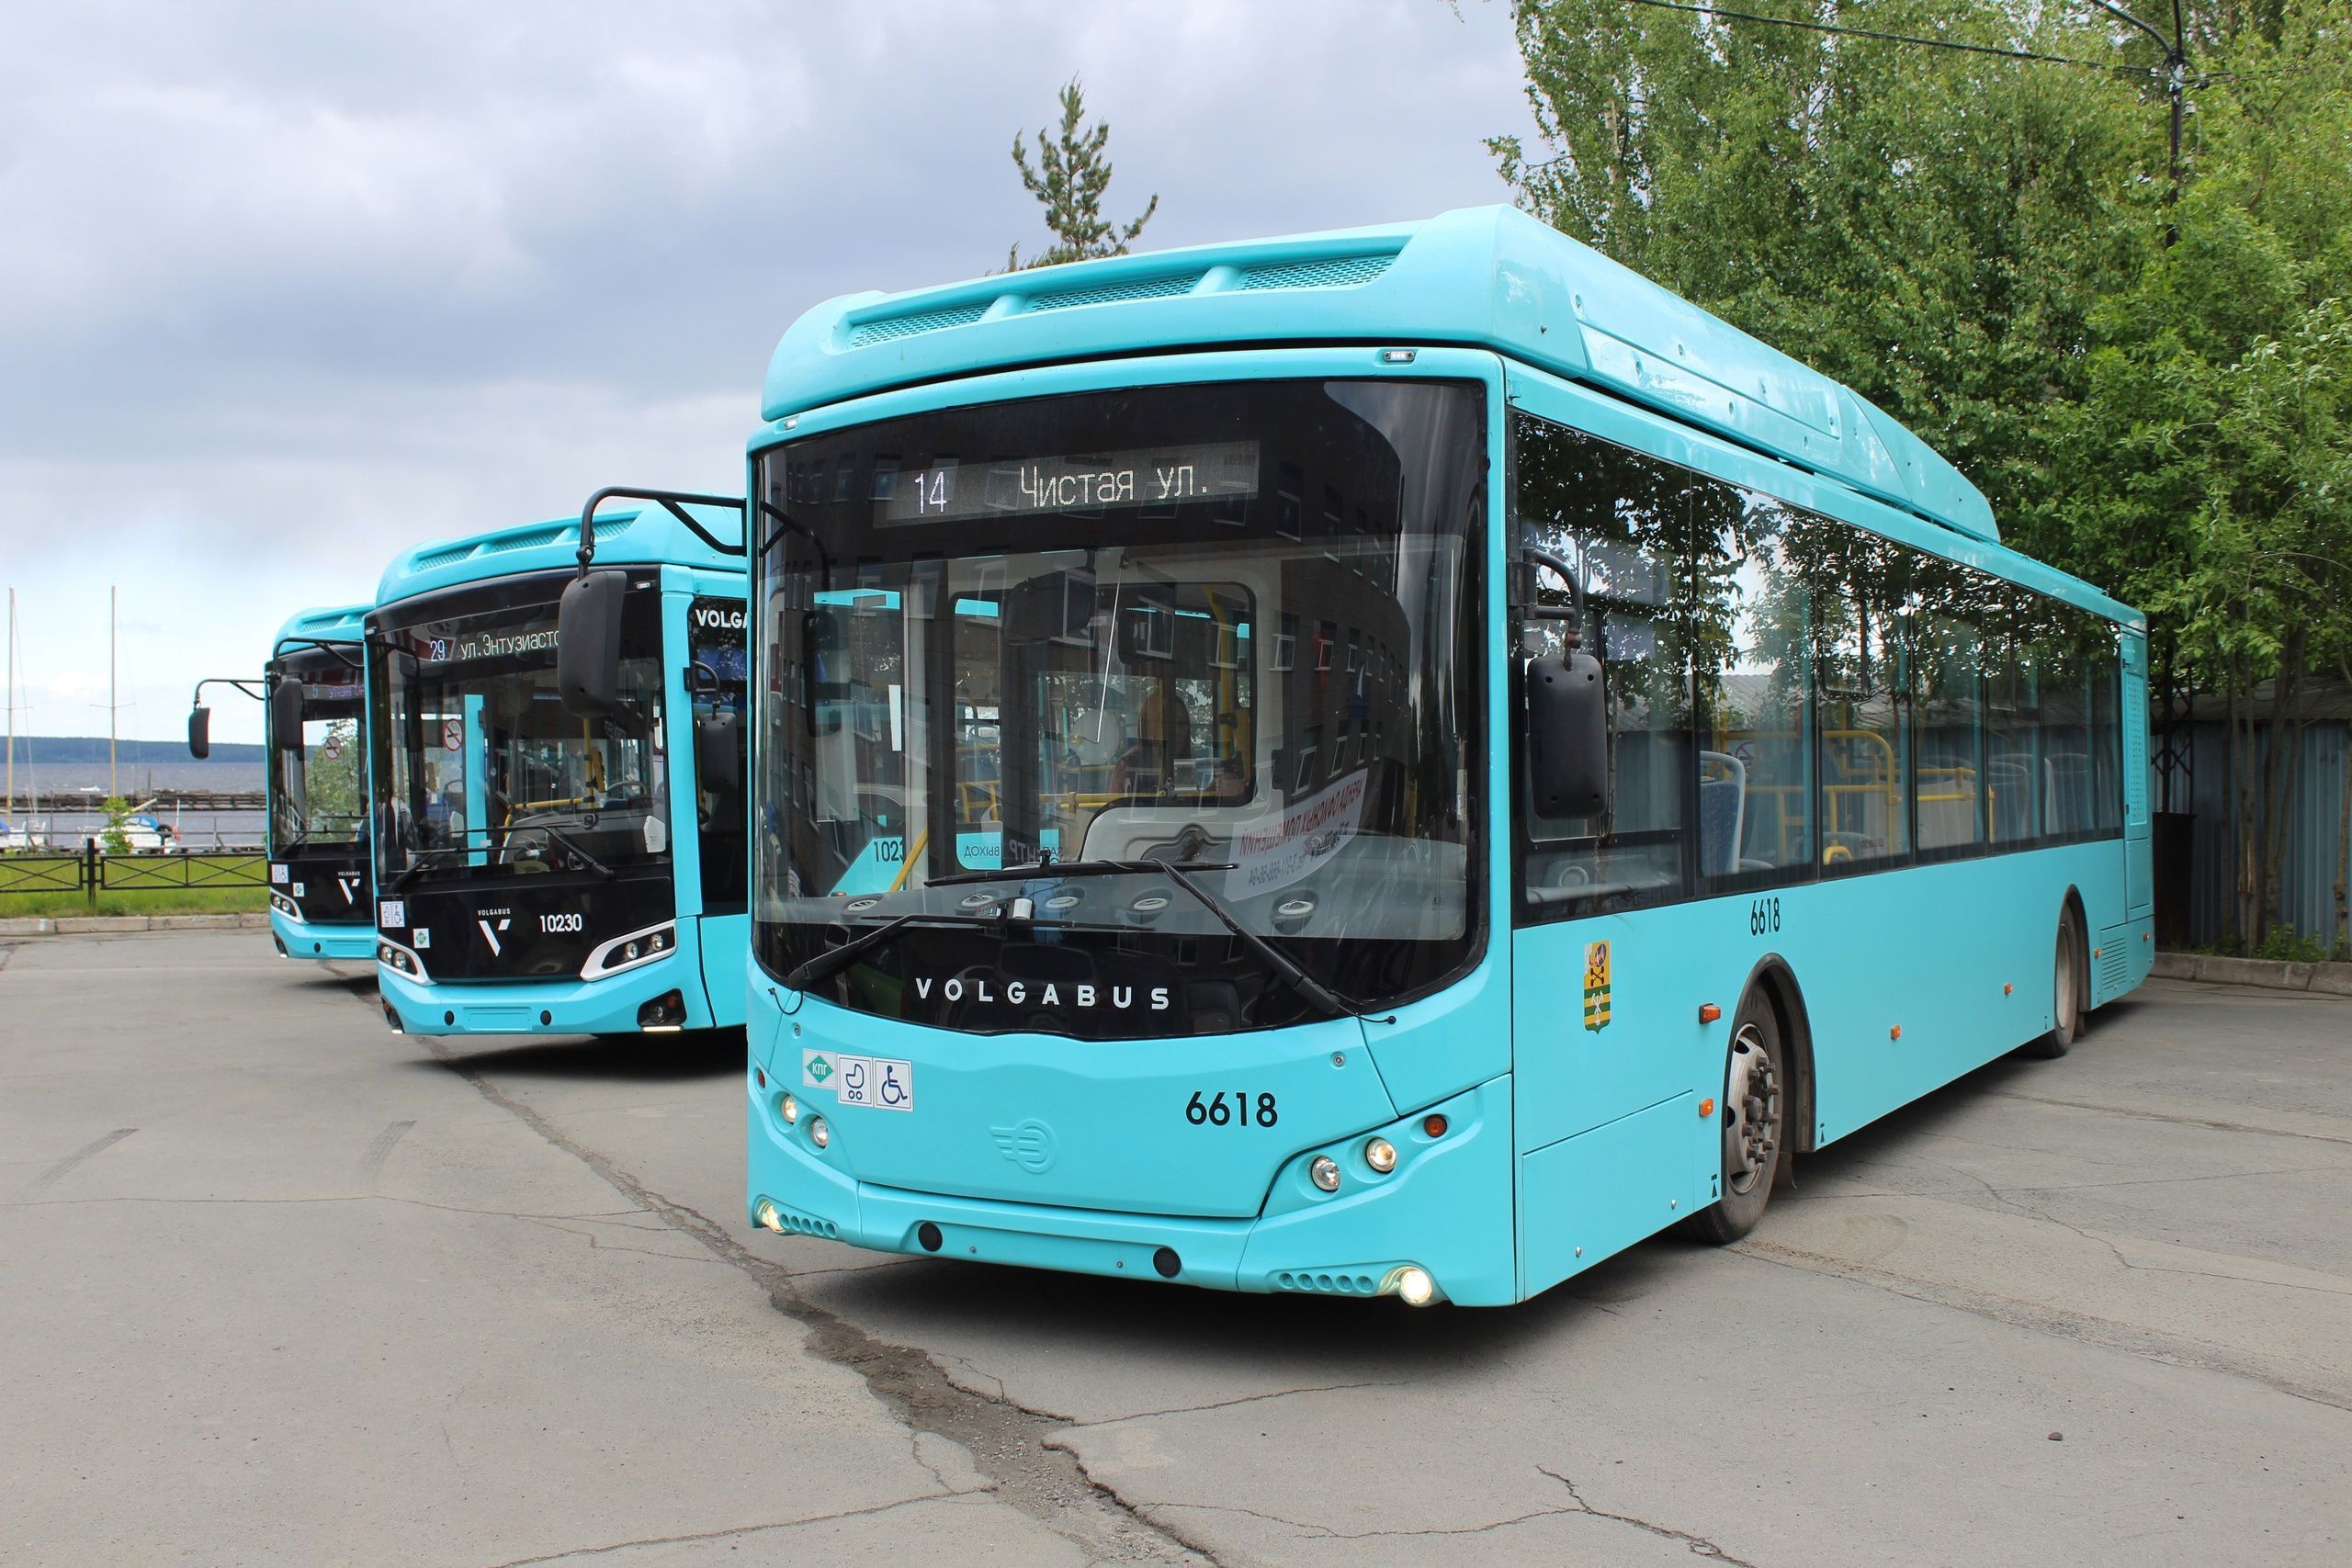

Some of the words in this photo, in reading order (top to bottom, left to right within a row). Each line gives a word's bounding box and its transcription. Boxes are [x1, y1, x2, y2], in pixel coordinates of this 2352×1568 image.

[914, 470, 947, 514] 14
[1021, 466, 1135, 507] Чистая
[1156, 465, 1208, 501] ул.
[430, 639, 446, 662] 29
[477, 908, 511, 916] VOLGABUS
[539, 913, 582, 932] 10230
[1750, 897, 1781, 936] 6618
[915, 977, 1170, 1010] VOLGABUS
[811, 1062, 828, 1076] КПГ
[1185, 1090, 1278, 1128] 6618
